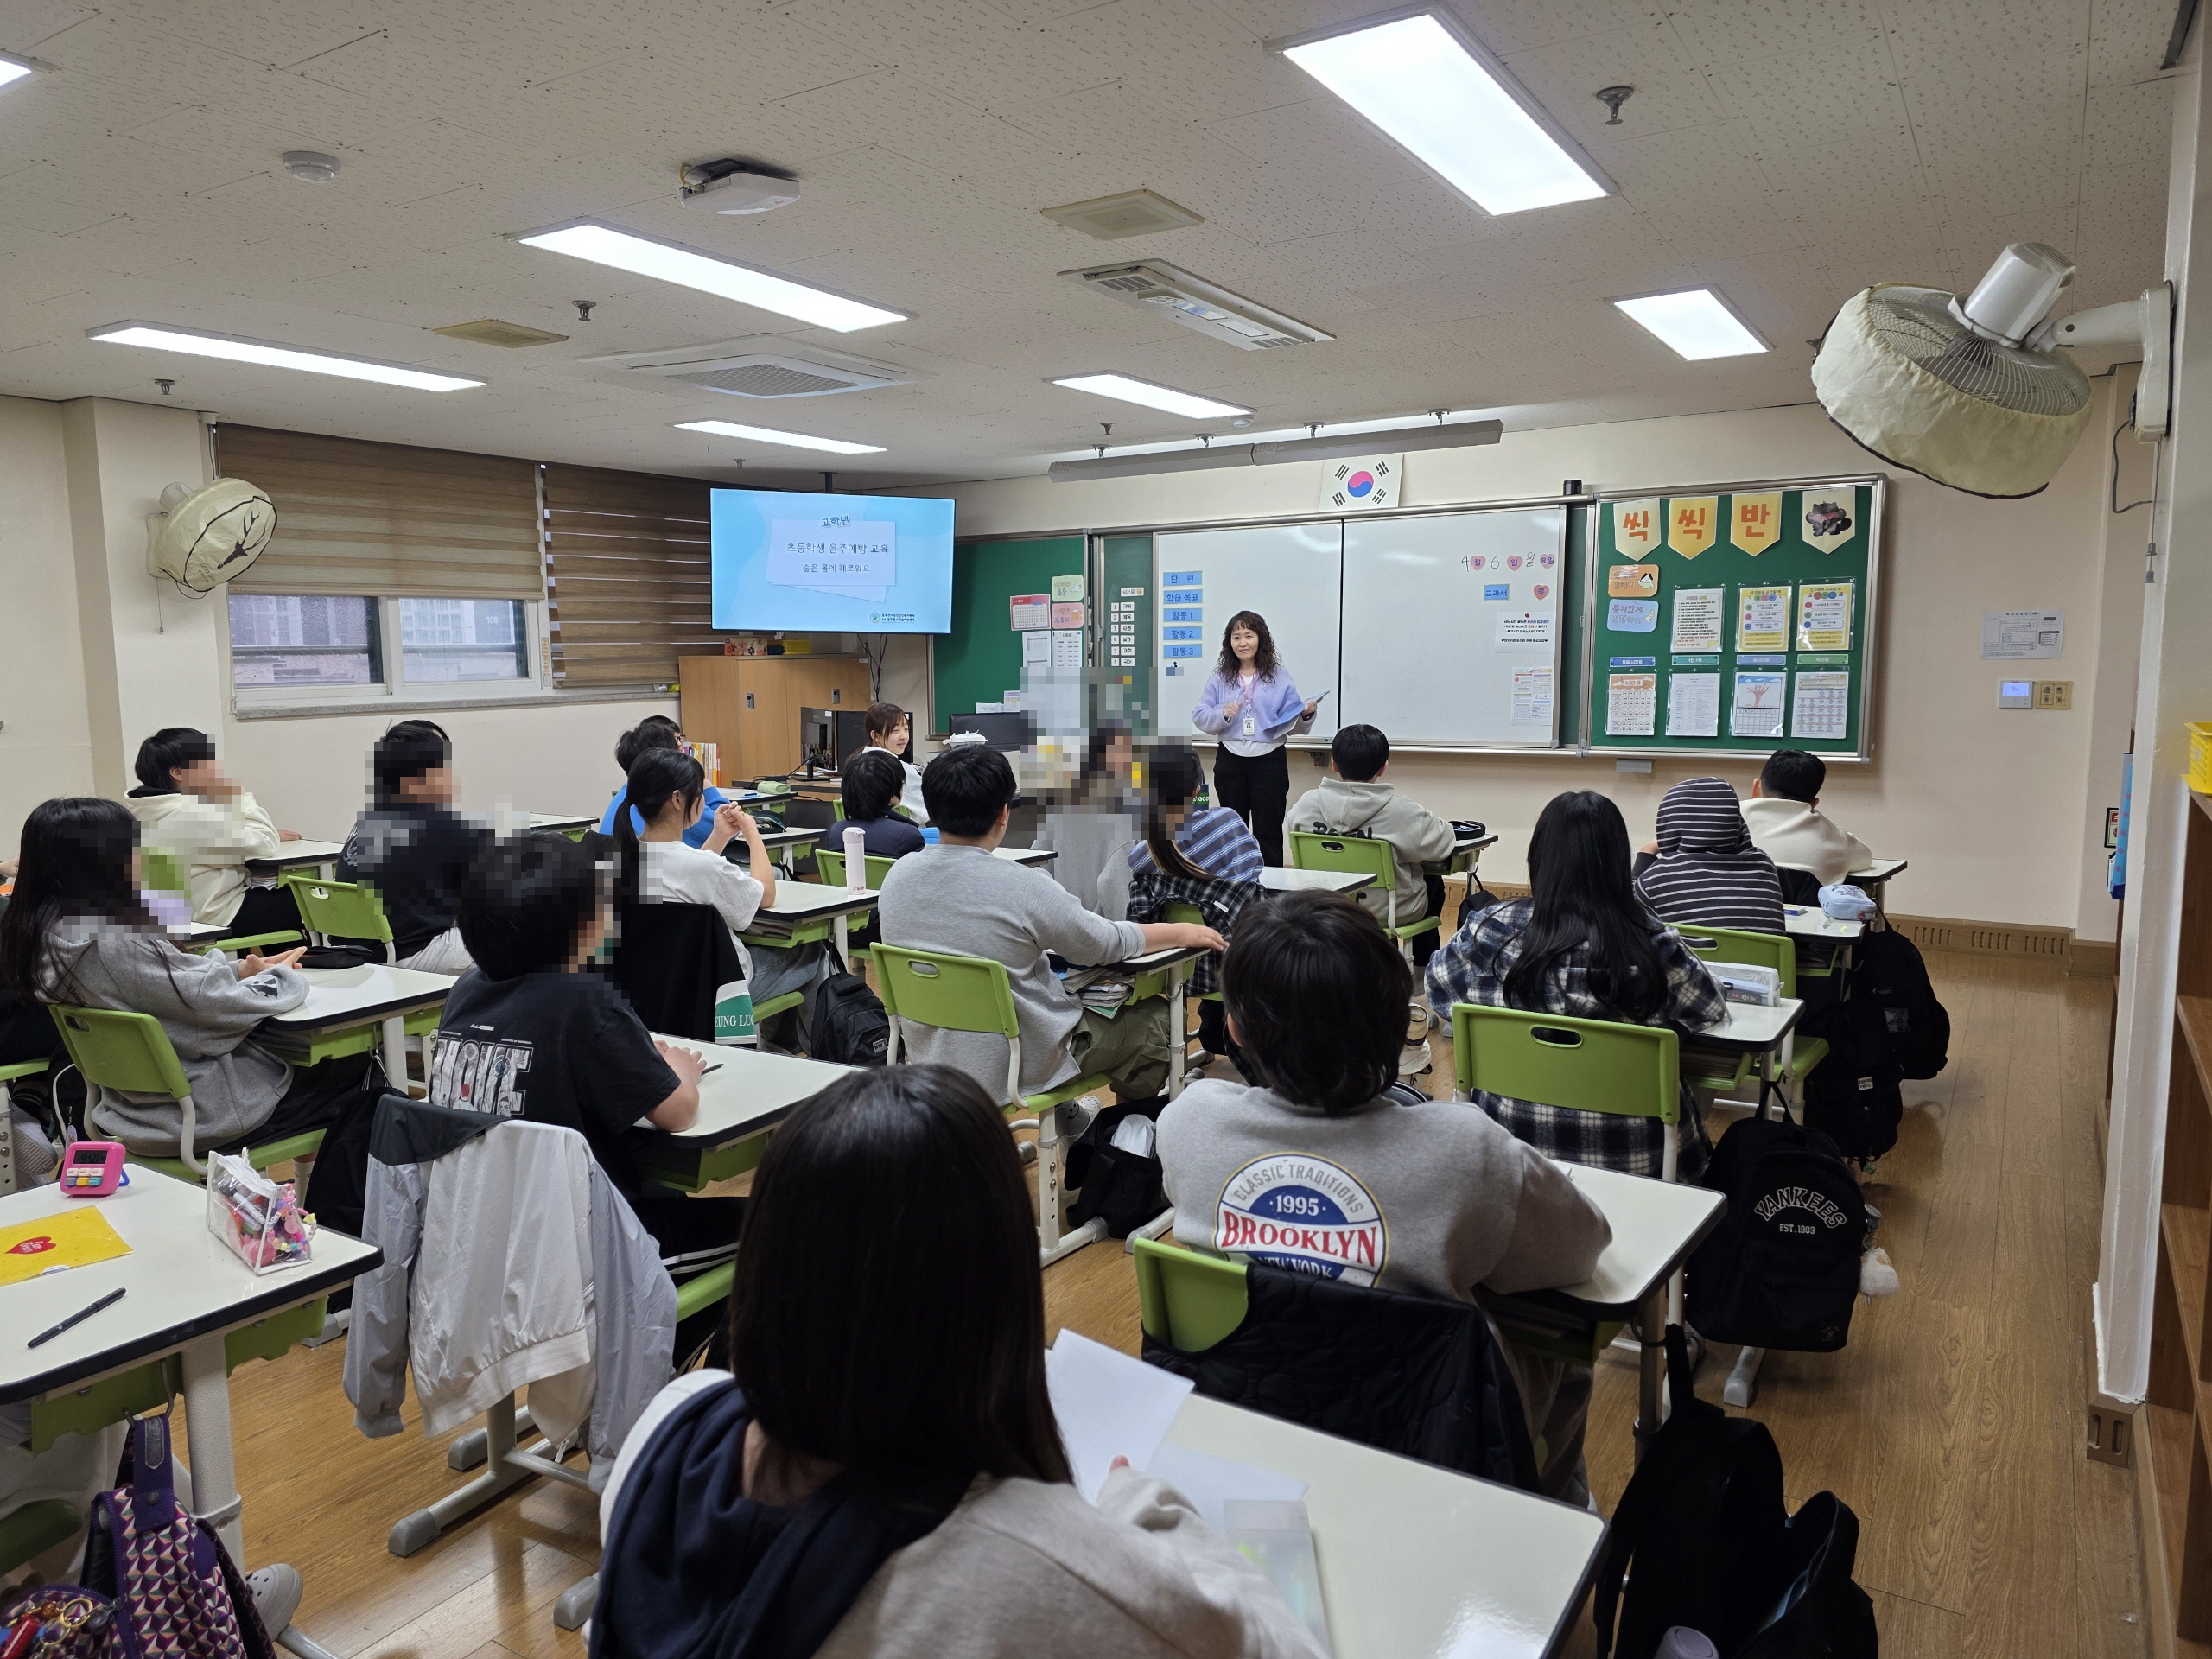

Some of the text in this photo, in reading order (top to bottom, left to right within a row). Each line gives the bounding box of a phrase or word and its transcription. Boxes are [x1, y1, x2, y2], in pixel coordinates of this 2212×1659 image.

[821, 516, 850, 528] 고학년
[1623, 504, 1770, 542] 씩 씩 반
[786, 543, 889, 555] 초등학생 음주예방 교육
[803, 564, 818, 573] 술은
[839, 564, 870, 573] 해로워요
[1491, 556, 1500, 569] 6
[1540, 556, 1555, 565] 요일
[1166, 593, 1199, 602] 학습 목표
[1172, 611, 1187, 620] 활동
[1172, 630, 1186, 639] 활동
[1172, 647, 1186, 657] 활동
[1234, 1165, 1364, 1213] CLASSIC TRADITIONS
[1276, 1194, 1319, 1217] 1995
[1754, 1186, 1847, 1228] YANKEES
[1221, 1210, 1377, 1268] BROOKLYN
